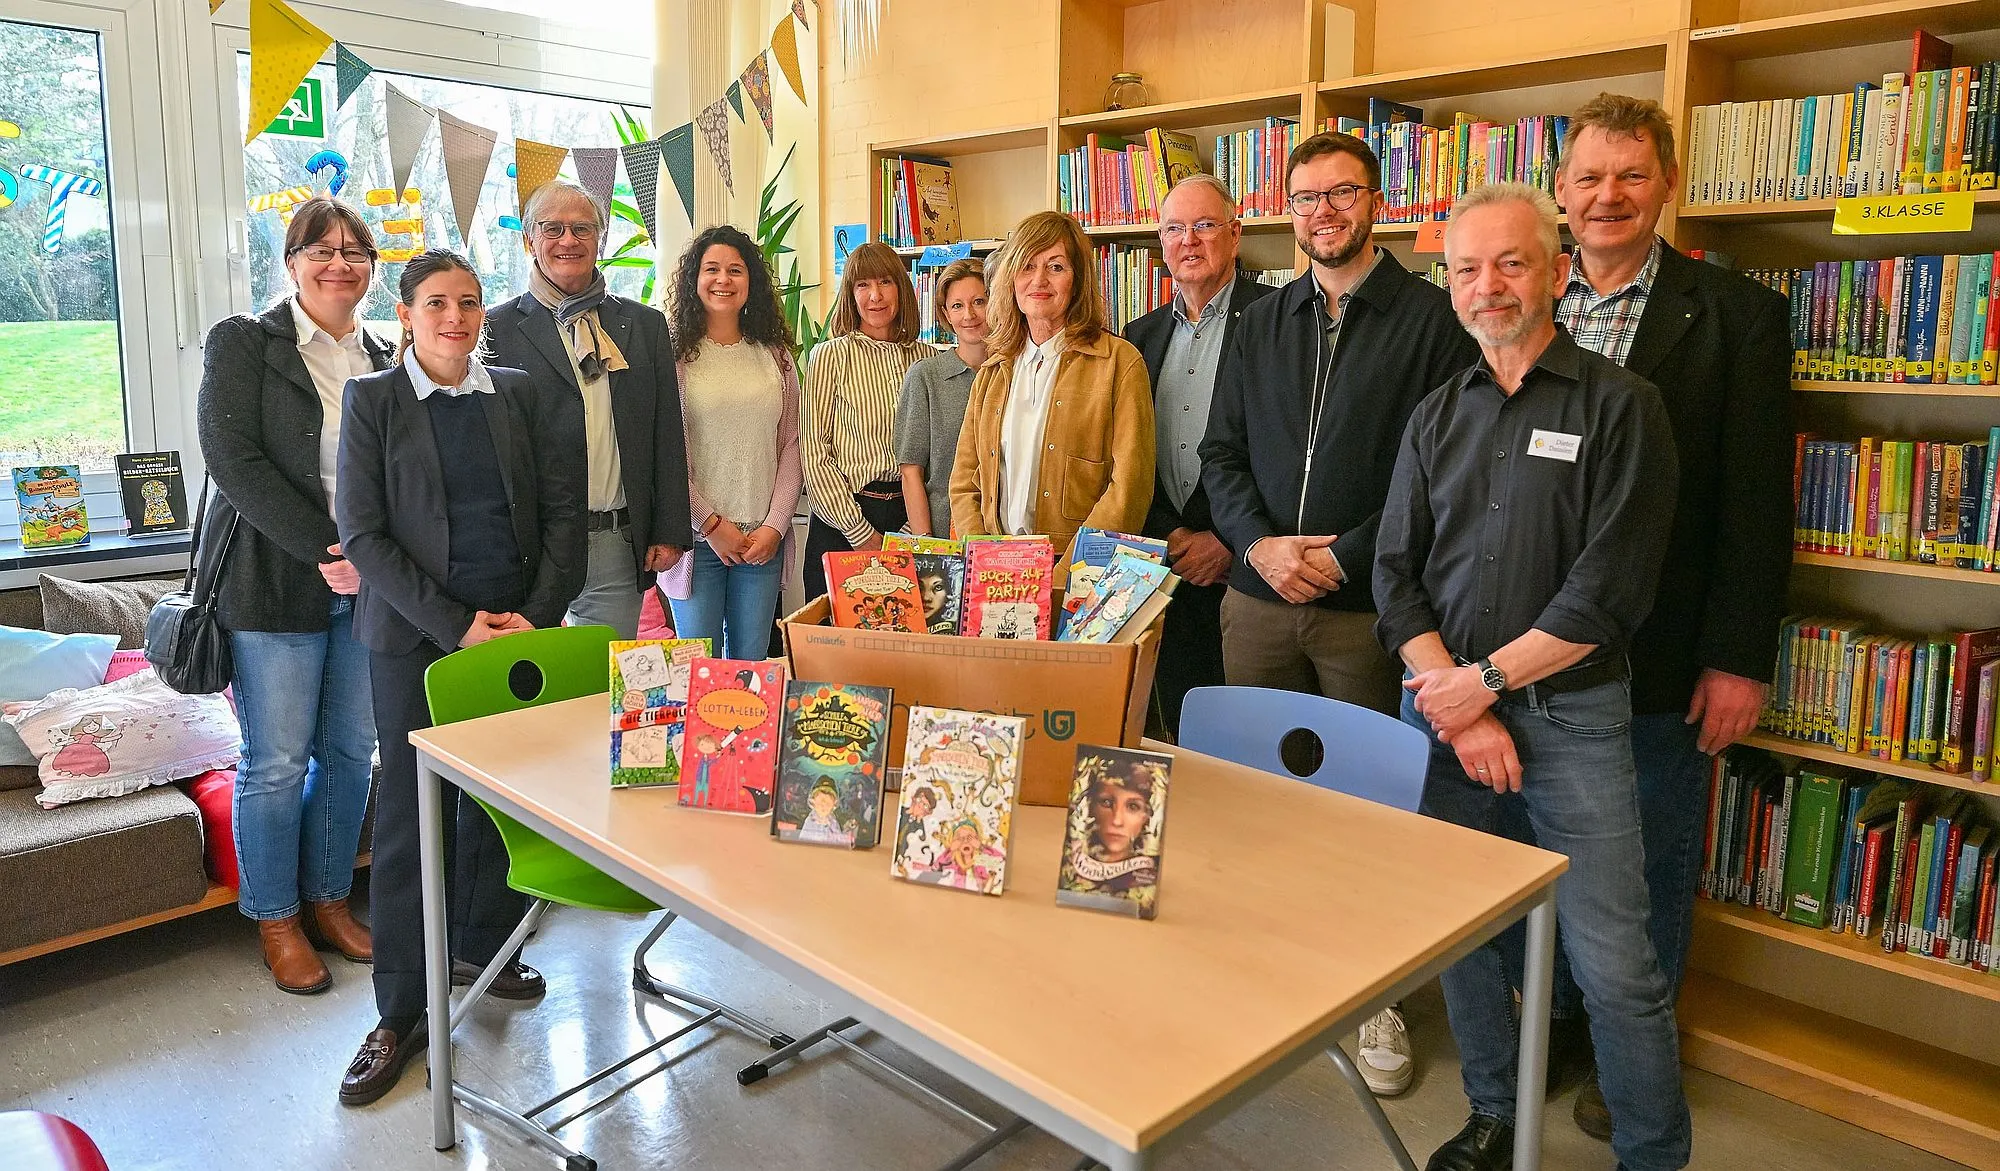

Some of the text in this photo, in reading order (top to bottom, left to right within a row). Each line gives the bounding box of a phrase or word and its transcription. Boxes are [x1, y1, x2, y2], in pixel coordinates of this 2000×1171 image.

[1852, 86, 1864, 132] Klassenzimmer
[1884, 112, 1897, 146] Emil
[1167, 139, 1193, 152] Pinocchio
[1909, 166, 1918, 175] A
[1962, 168, 1969, 176] A
[1930, 176, 1937, 184] A
[1946, 175, 1955, 184] A
[1972, 178, 1980, 186] A
[1984, 174, 1991, 182] A
[1435, 230, 1443, 239] 2.
[1797, 357, 1804, 366] B
[1810, 361, 1816, 369] B
[1850, 358, 1856, 366] B
[1862, 361, 1868, 369] B
[1875, 361, 1882, 369] B
[1937, 361, 1945, 369] B
[1983, 360, 1992, 372] B
[1916, 364, 1925, 372] B
[1971, 362, 1978, 371] B
[1837, 368, 1845, 376] B
[1896, 372, 1902, 381] 3
[1929, 499, 1937, 514] NICHT
[1927, 515, 1937, 531] BITTE
[979, 568, 1044, 583] BOCK AUF
[986, 584, 1040, 600] PARTY?
[806, 633, 847, 647] Umläufe
[704, 704, 766, 716] LOTTA-LEBEN
[626, 713, 641, 724] DIE
[1924, 742, 1931, 750] M
[1975, 759, 1983, 767] M
